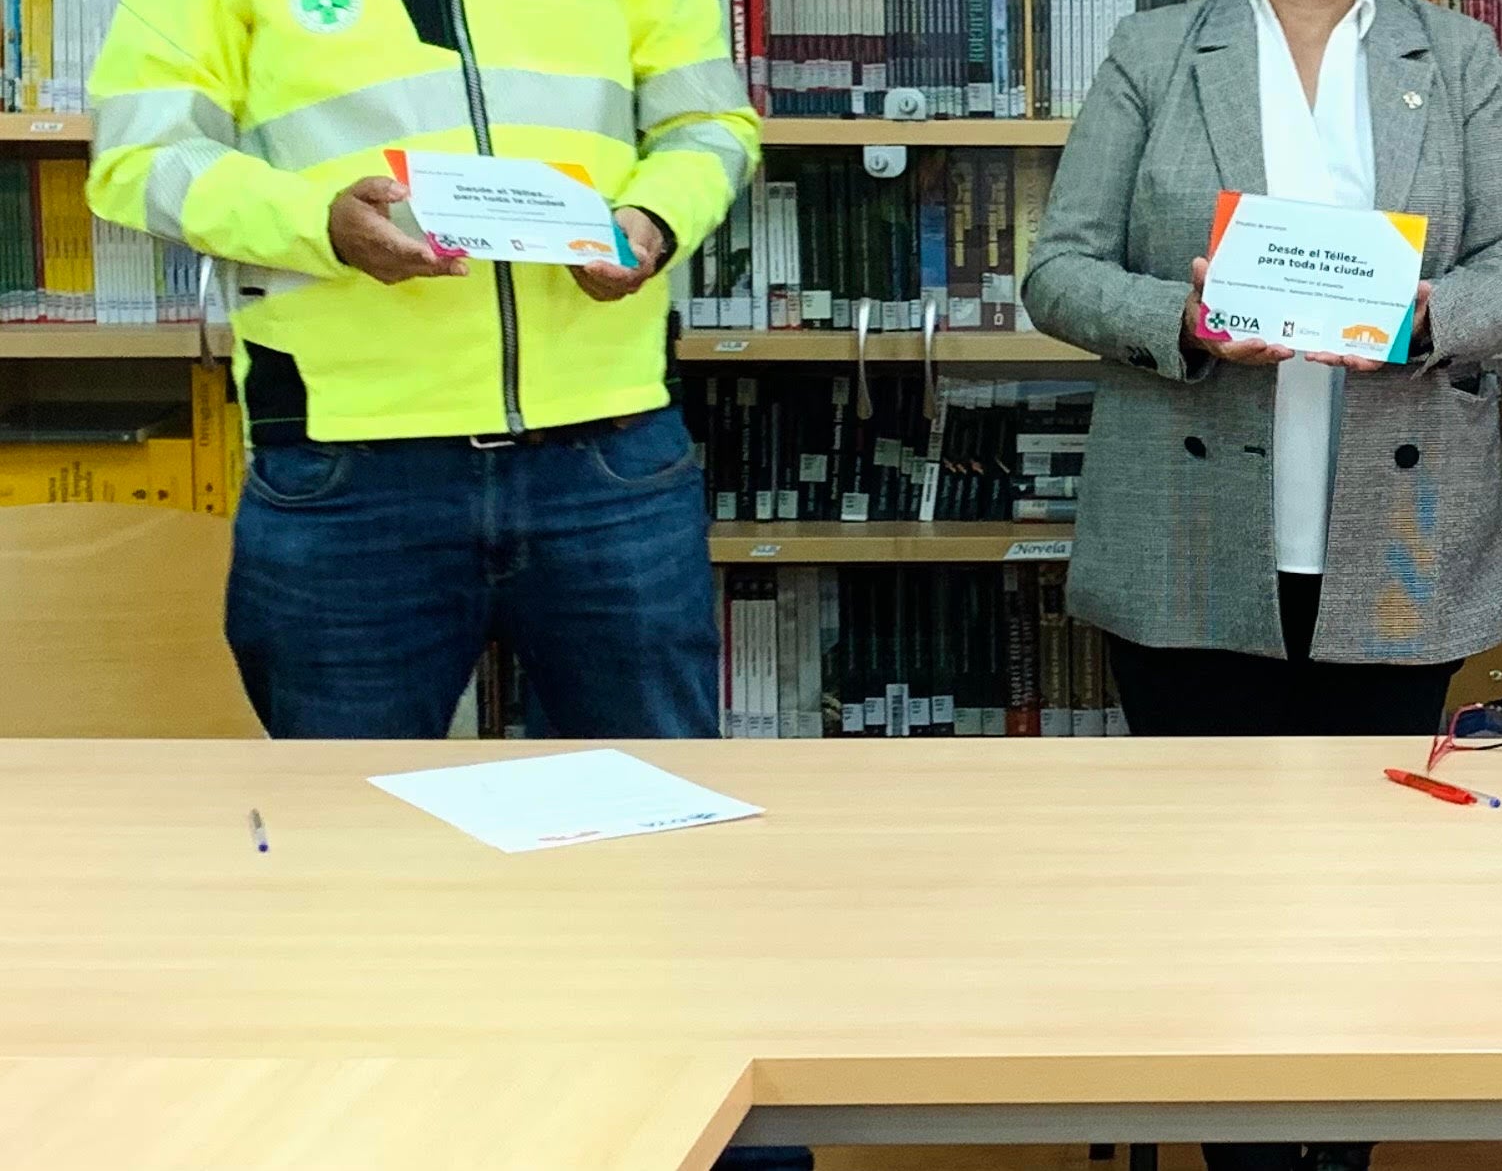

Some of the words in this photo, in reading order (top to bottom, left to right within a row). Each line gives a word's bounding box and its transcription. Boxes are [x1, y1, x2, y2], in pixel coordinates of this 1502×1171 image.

[734, 5, 746, 64] HARLEY
[458, 236, 493, 248] DYA
[1268, 243, 1304, 256] Desde
[1309, 250, 1320, 258] el
[1258, 255, 1285, 266] para
[1289, 259, 1315, 271] toda
[1320, 262, 1330, 272] la
[1334, 265, 1374, 278] ciudad
[1229, 315, 1260, 330] DYA
[1012, 542, 1067, 555] Novela
